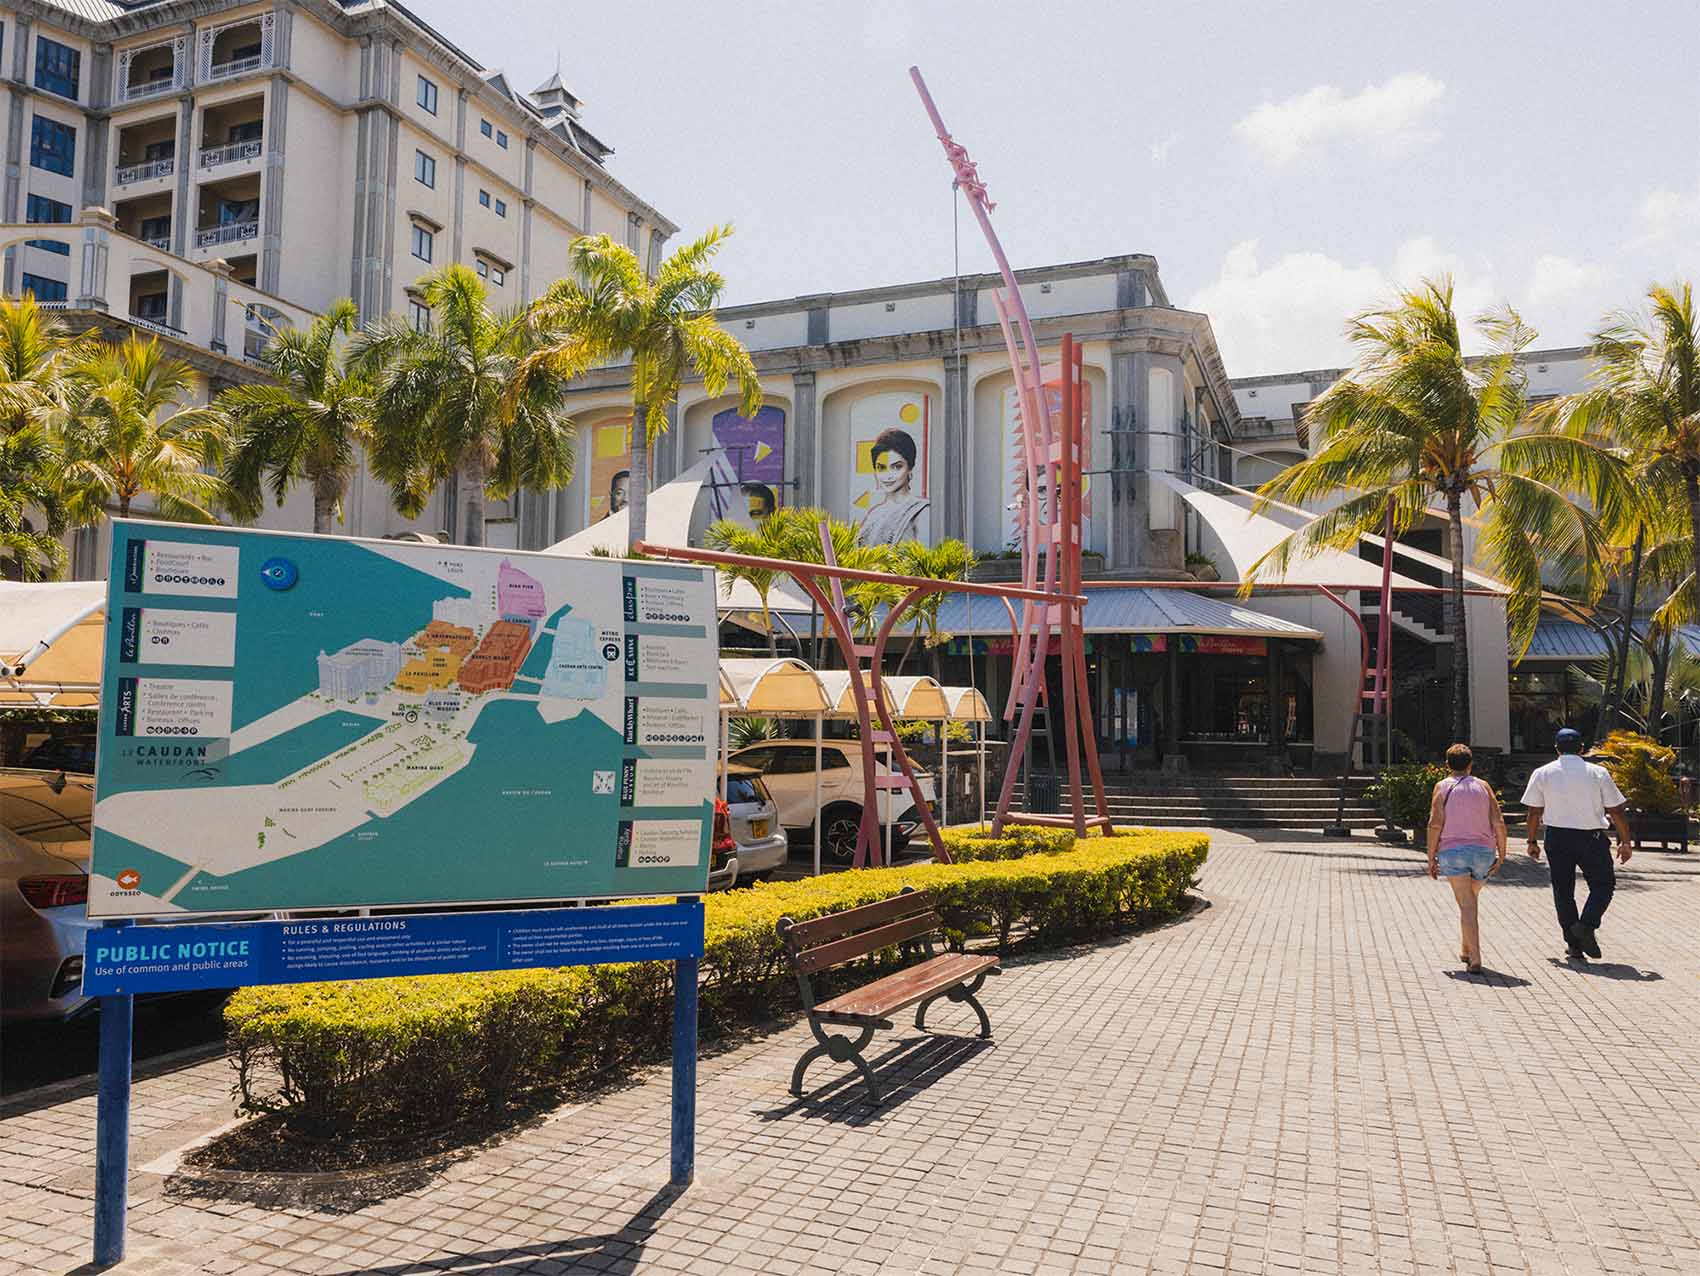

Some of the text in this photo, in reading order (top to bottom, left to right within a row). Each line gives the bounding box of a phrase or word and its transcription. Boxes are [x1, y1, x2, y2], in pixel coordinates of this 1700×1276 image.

[136, 746, 207, 757] CAUDAN
[136, 759, 206, 767] WATERFRONT
[283, 921, 407, 935] RULES & REGULATIONS
[96, 940, 249, 963] PUBLIC NOTICE
[95, 959, 249, 976] Use of common and public areas
